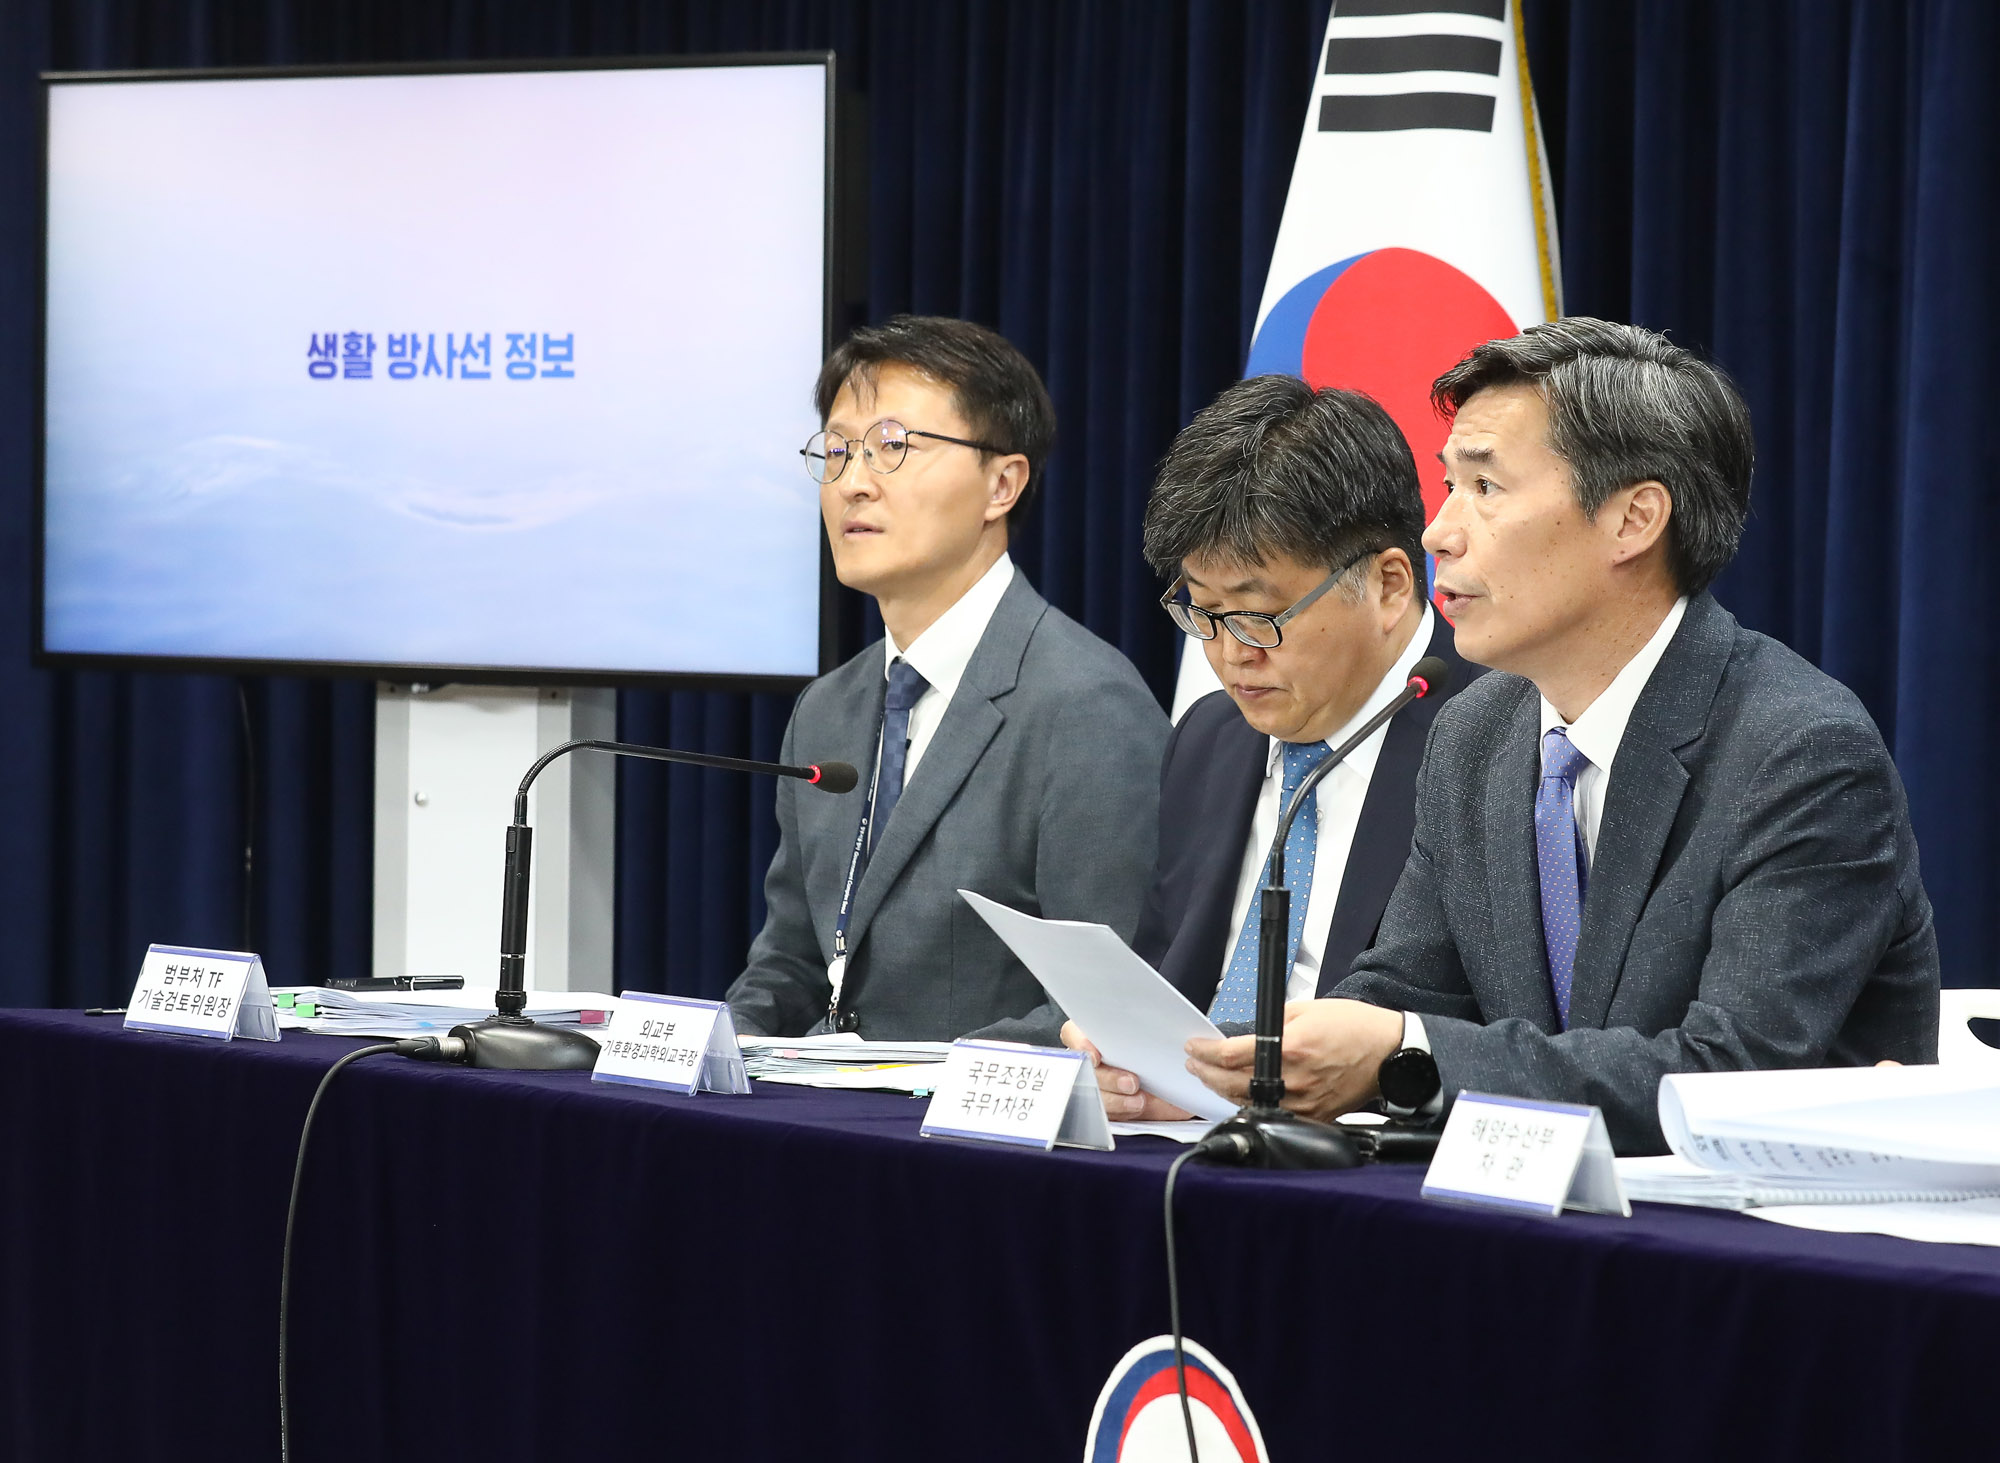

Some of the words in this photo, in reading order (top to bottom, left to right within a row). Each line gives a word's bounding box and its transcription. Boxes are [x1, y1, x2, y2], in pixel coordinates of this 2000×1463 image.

[307, 331, 376, 380] 생활
[387, 332, 492, 380] 방사선
[505, 332, 576, 380] 정보
[164, 964, 204, 988] 범부처
[208, 971, 224, 988] TF
[138, 988, 231, 1018] 기술검토위원장
[639, 1019, 676, 1041] 외교부
[603, 1039, 698, 1067] 기후환경과학외교국장
[968, 1060, 1050, 1092] 국무조정실
[961, 1091, 1034, 1121] 국무1차장
[1471, 1117, 1555, 1150] 해양수산부
